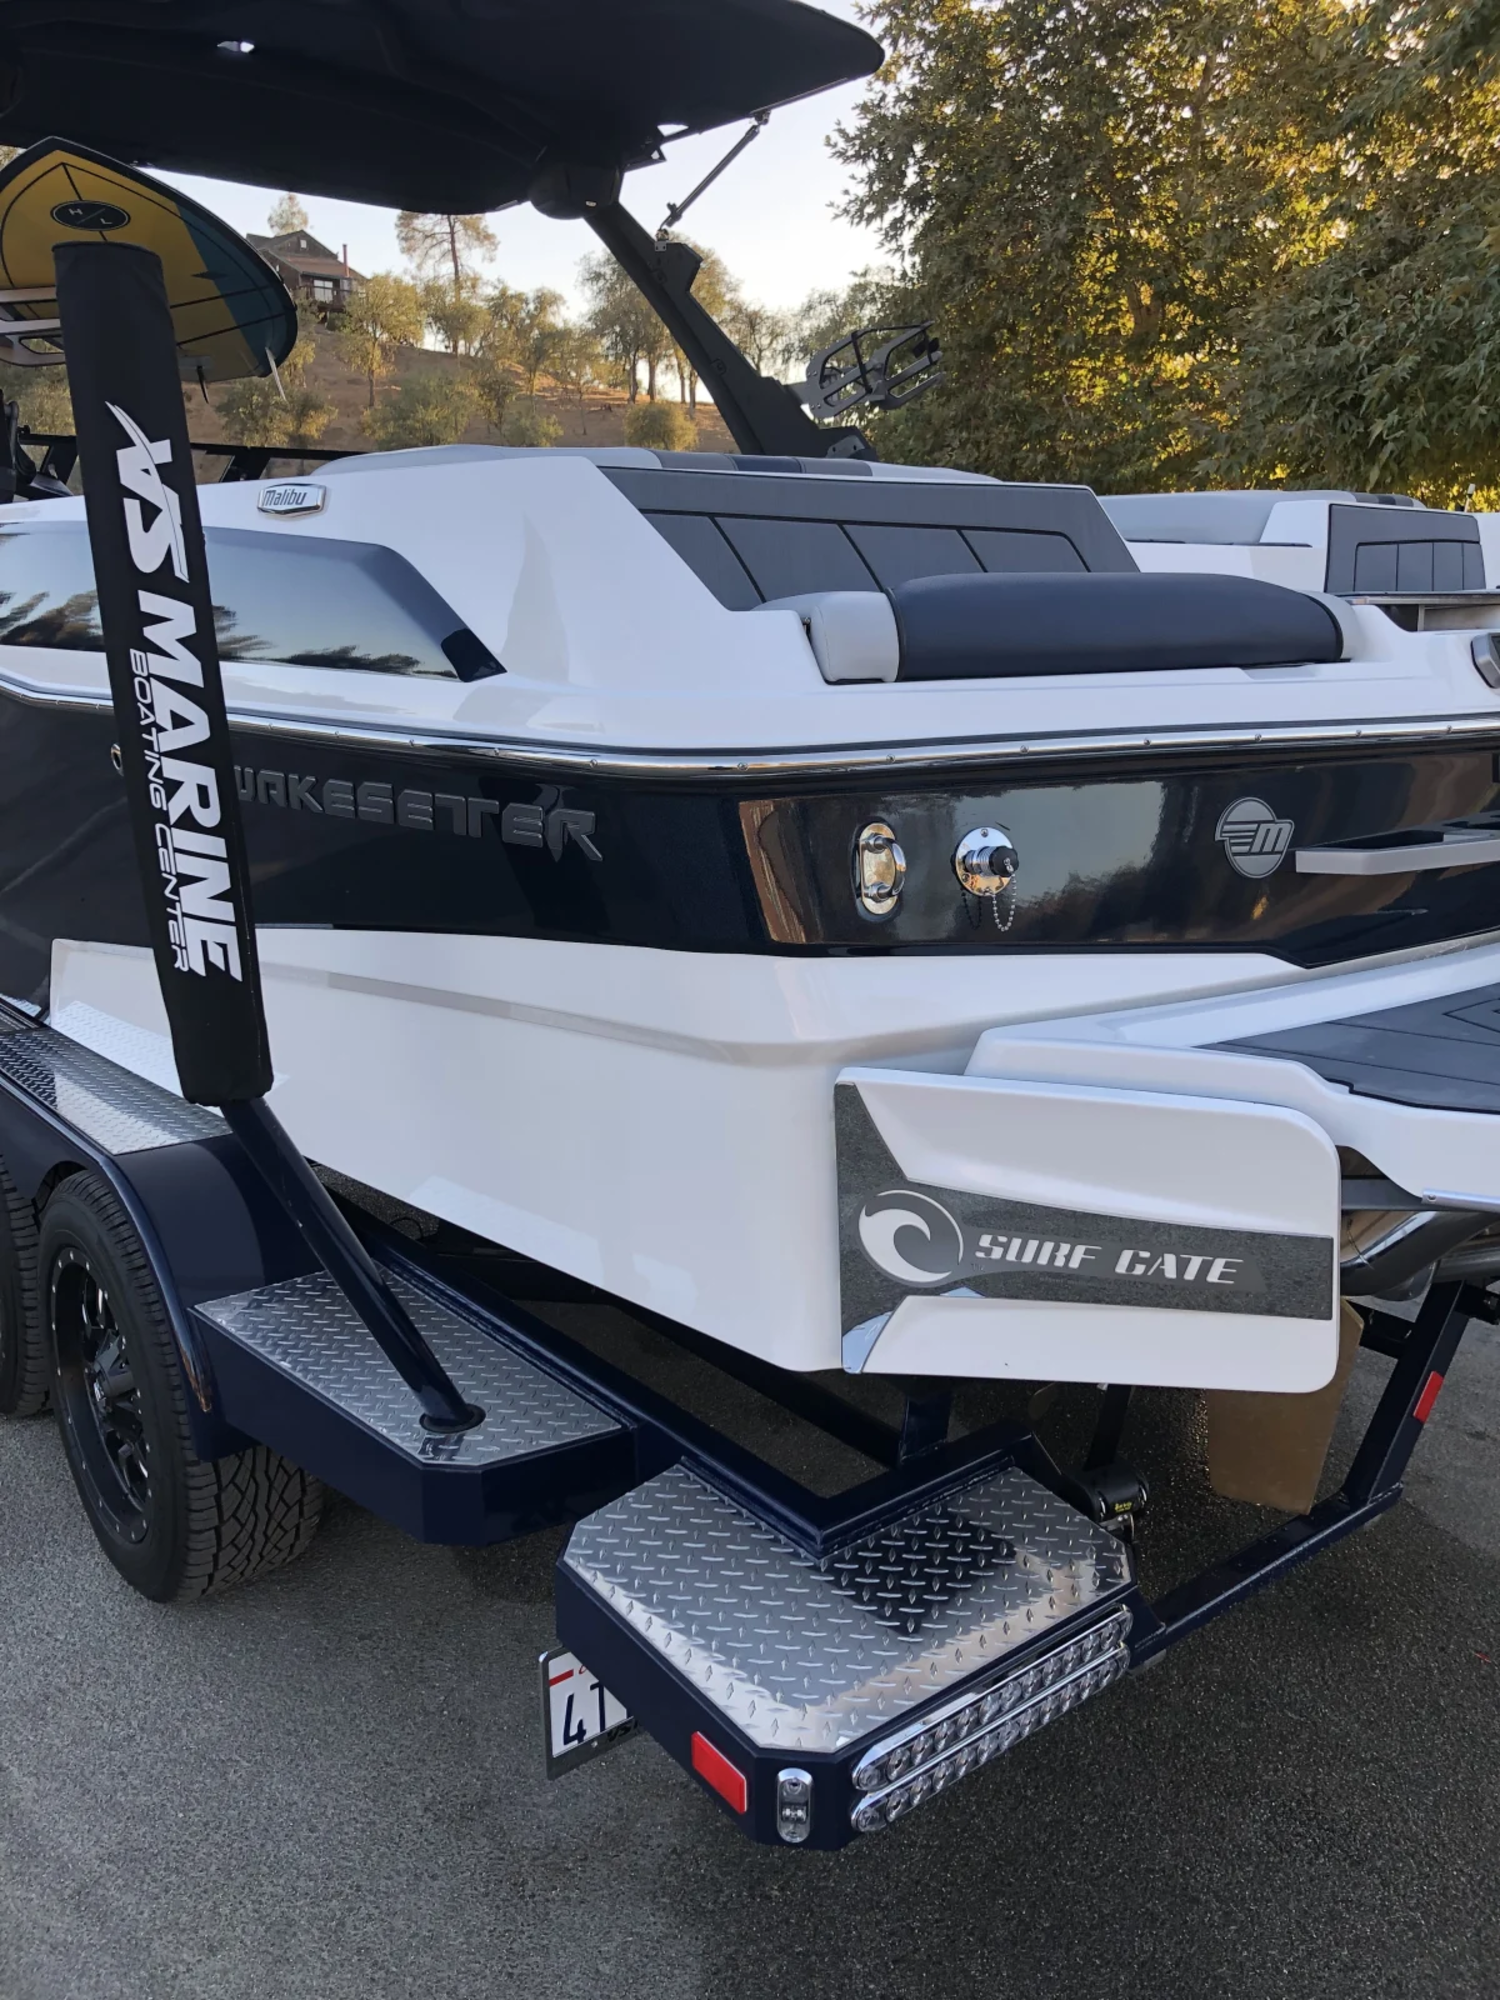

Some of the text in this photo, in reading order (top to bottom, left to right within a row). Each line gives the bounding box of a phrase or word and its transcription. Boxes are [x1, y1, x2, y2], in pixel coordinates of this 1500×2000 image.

[265, 488, 308, 507] Malibu
[129, 648, 190, 972] BOATING CENTER
[137, 589, 243, 982] MARINE
[975, 1233, 1245, 1285] SURF GATE
